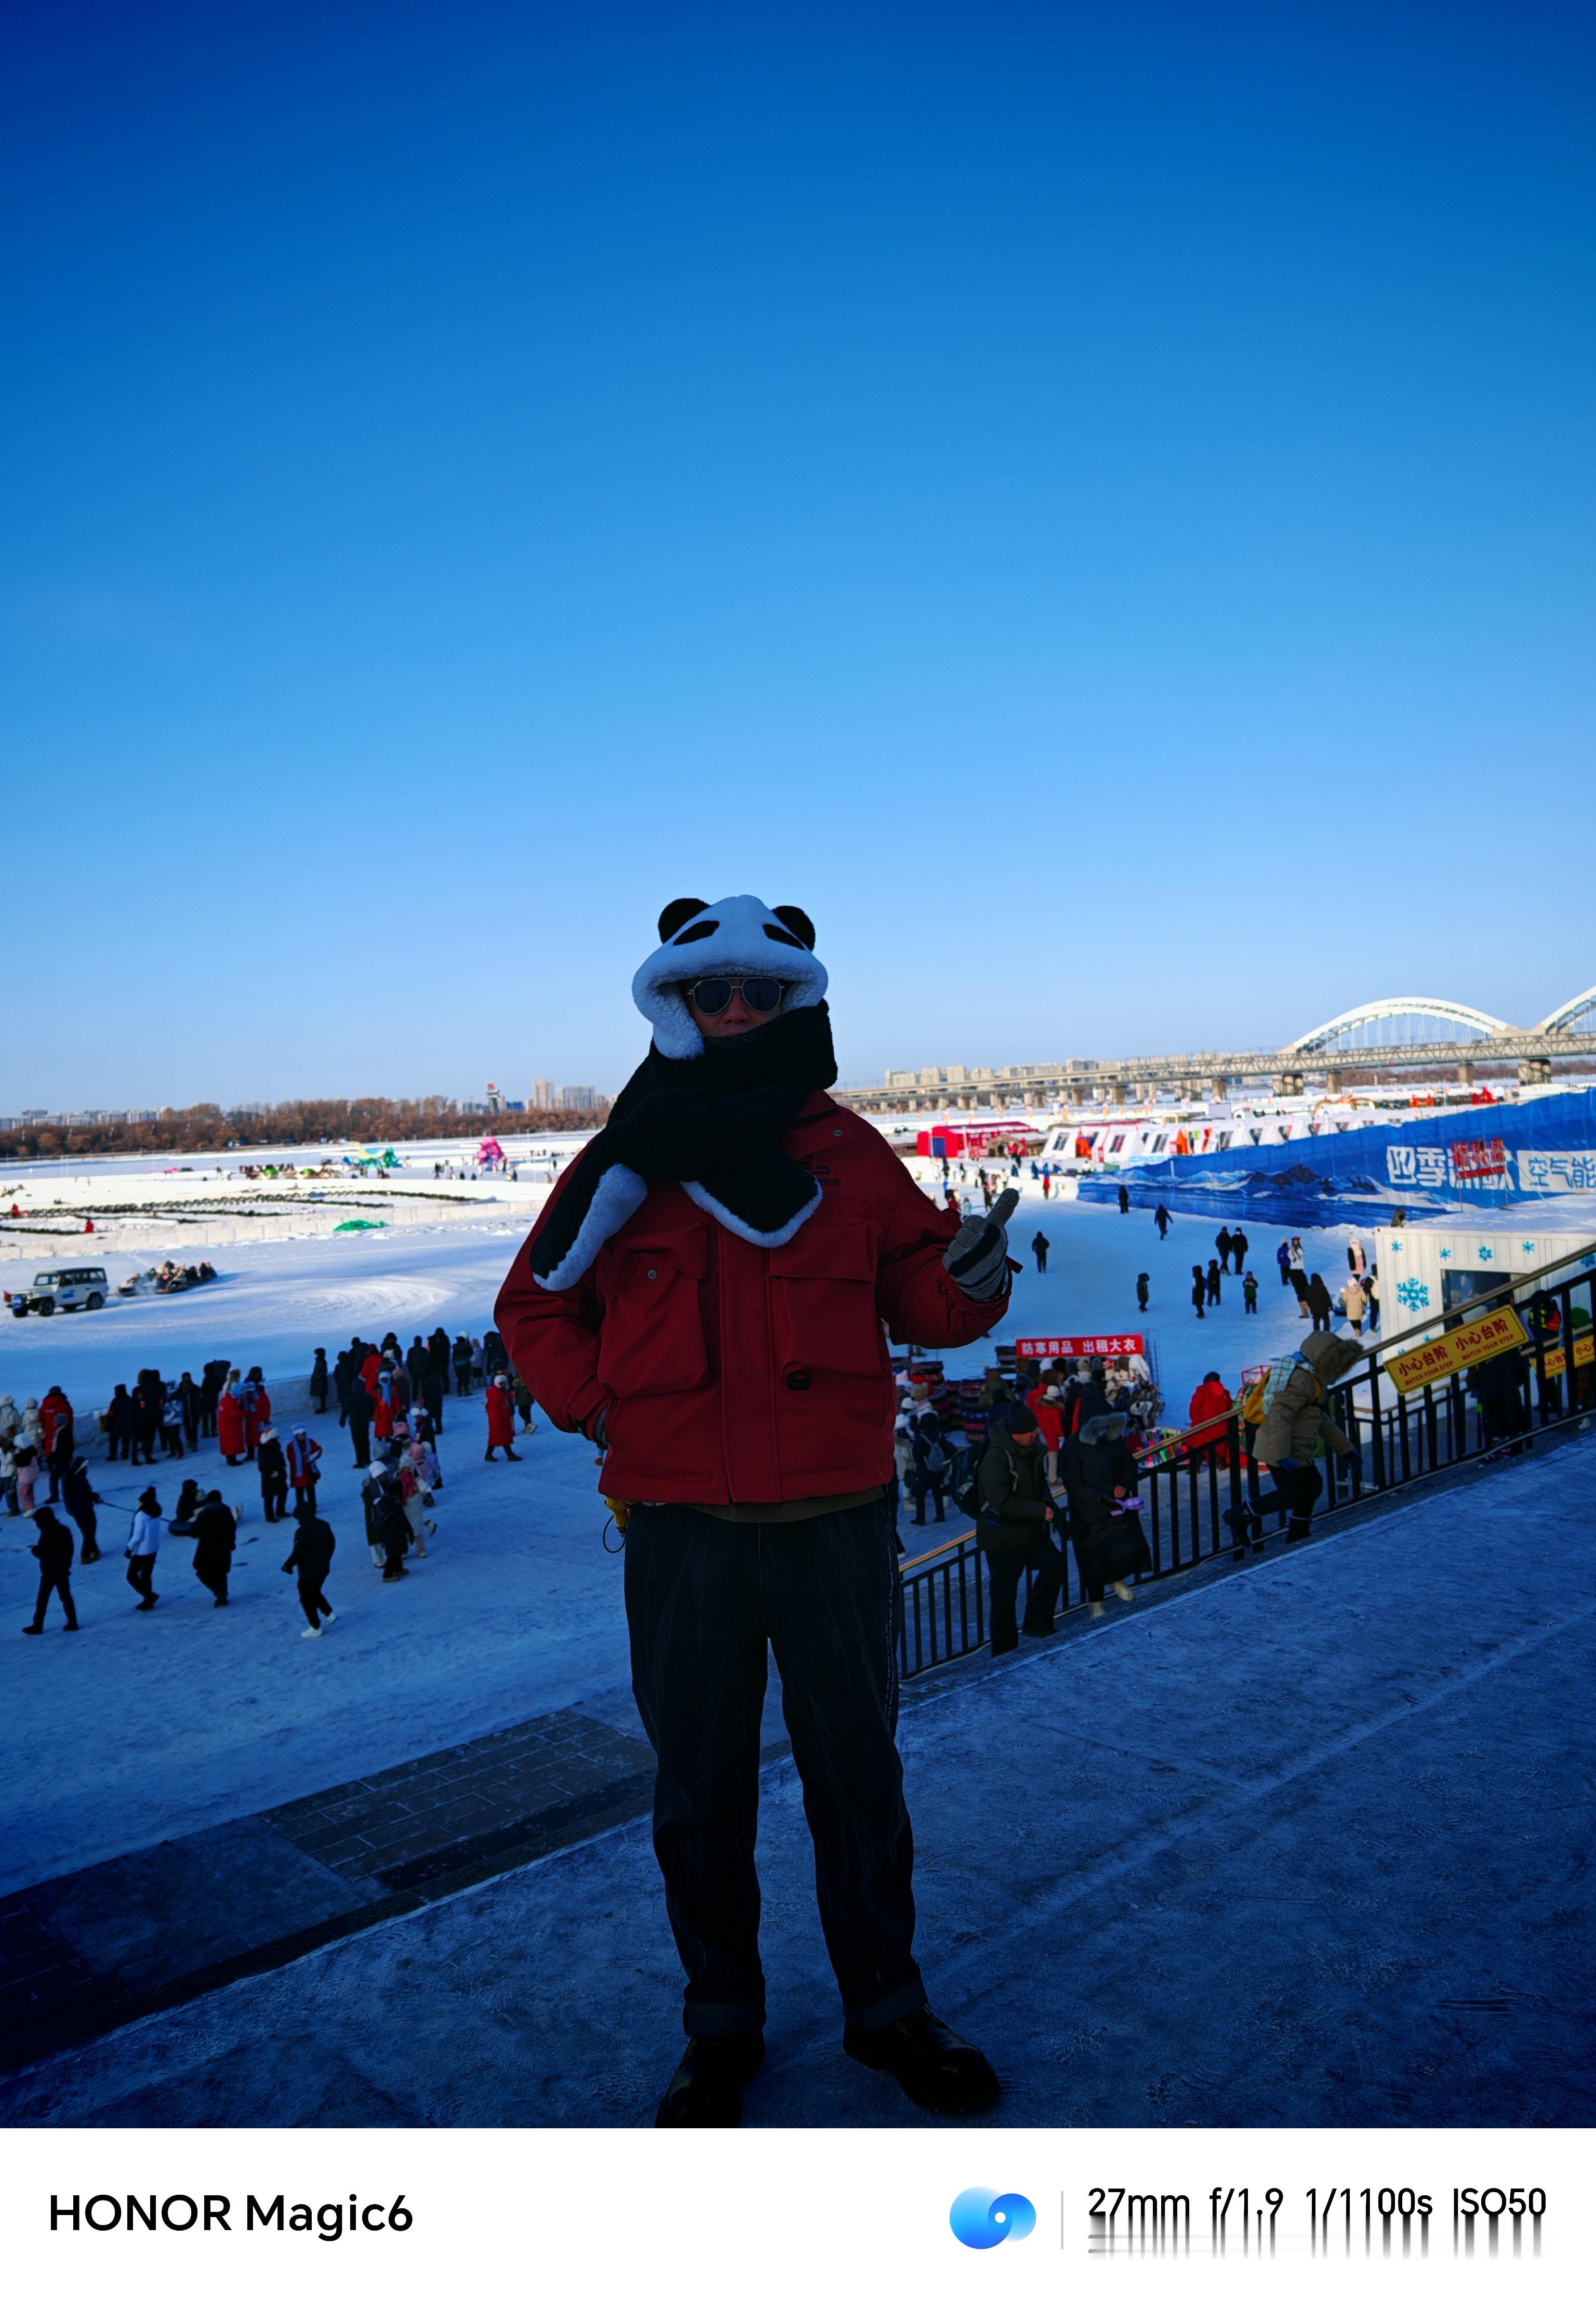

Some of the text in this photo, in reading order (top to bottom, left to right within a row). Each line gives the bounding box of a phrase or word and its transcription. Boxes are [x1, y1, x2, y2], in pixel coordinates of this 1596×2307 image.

[1528, 1157, 1596, 1189] 空气能
[1022, 1337, 1137, 1355] 防寒用品 出租大衣
[1399, 1318, 1509, 1377] 小心台阶 小心台阶
[1404, 1333, 1514, 1386] WATCH YOUR STEP WATCH YOUR STEP
